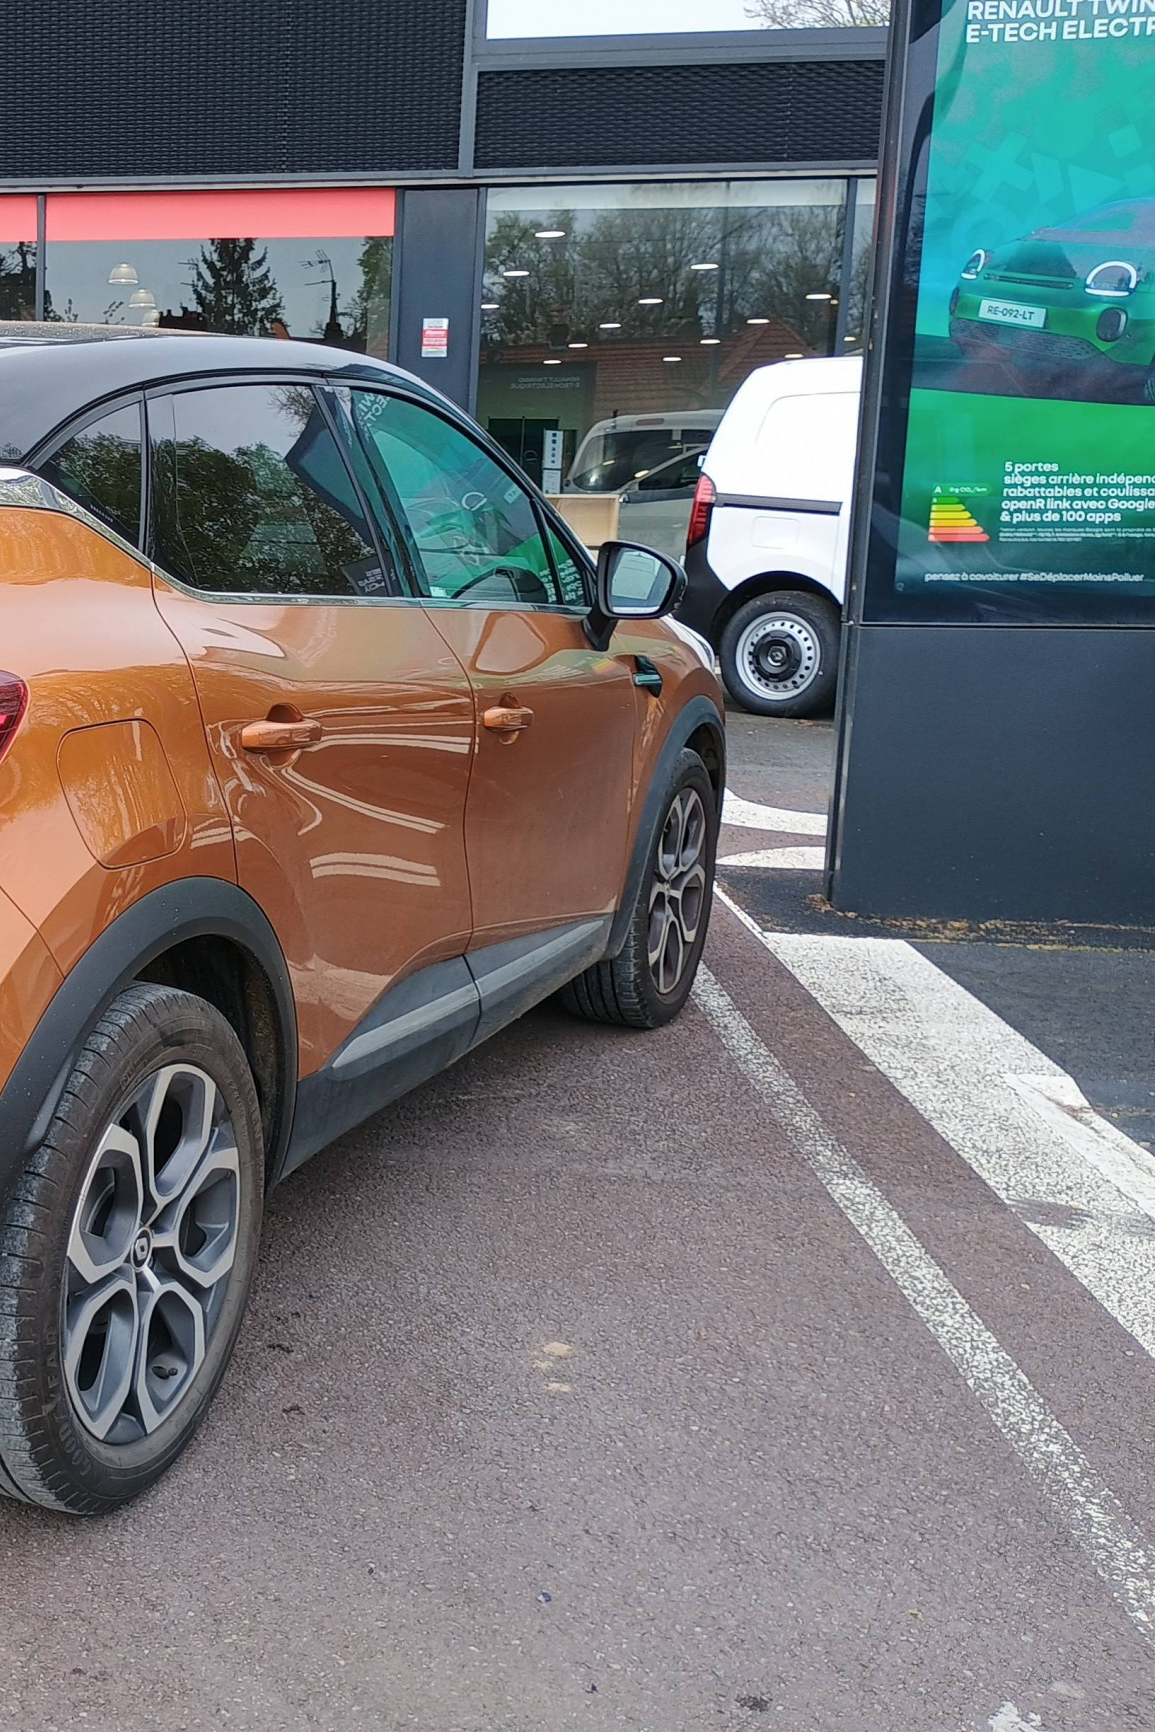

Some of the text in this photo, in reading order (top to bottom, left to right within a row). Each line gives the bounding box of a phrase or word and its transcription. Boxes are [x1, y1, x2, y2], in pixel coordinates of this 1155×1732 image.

[967, 0, 1083, 20] RENAULT
[966, 21, 1057, 43] E-TECH
[987, 305, 1035, 320] RE-092-LT
[1004, 461, 1059, 474] 5 portes
[1003, 473, 1047, 487] sièges
[1048, 473, 1094, 484] arrière
[1003, 485, 1082, 497] rabattables
[1084, 487, 1099, 497] et
[1001, 497, 1155, 512] openR link avec Google
[1000, 510, 1122, 524] & plus de 100 apps
